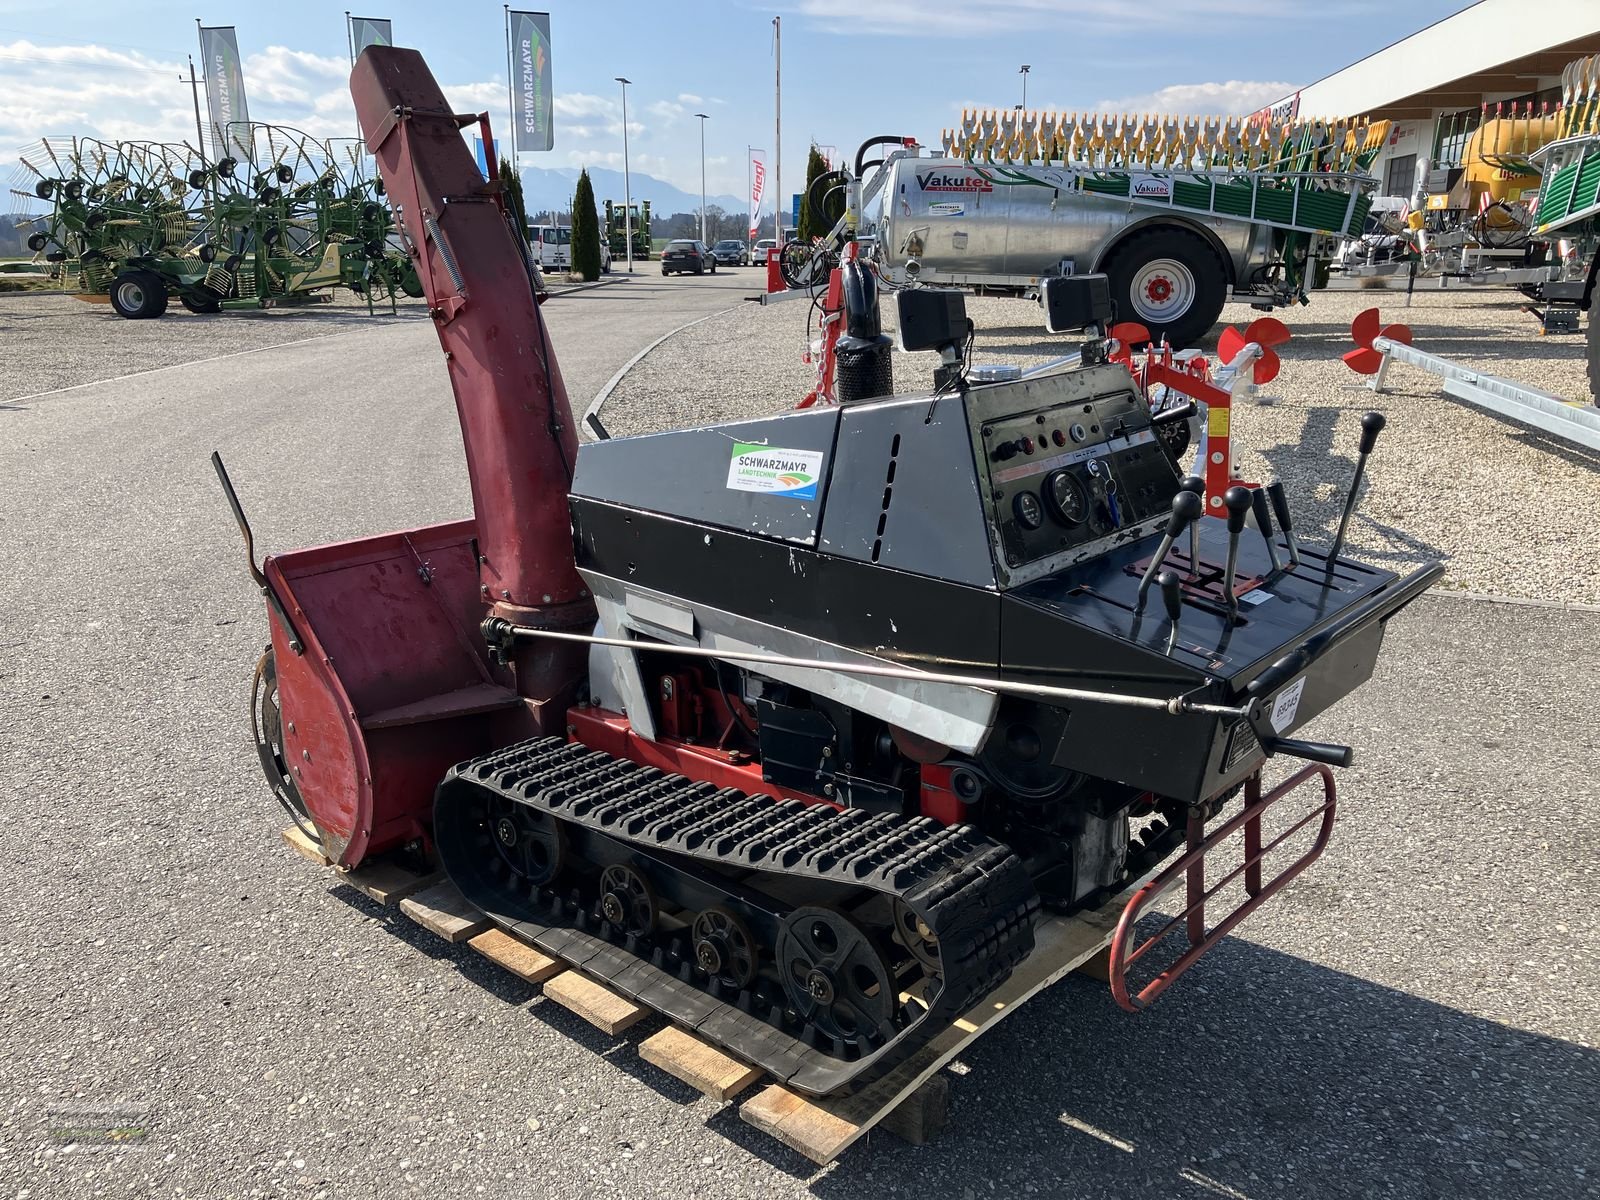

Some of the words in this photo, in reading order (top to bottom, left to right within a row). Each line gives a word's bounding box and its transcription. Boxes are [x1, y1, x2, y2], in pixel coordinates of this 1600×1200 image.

[522, 39, 535, 134] SCHWARZMAYR
[752, 159, 766, 203] Fliegl
[1134, 183, 1169, 194] Vakutec
[738, 456, 807, 473] SCHWARZMAYR
[737, 468, 778, 480] LANDTECHNIK
